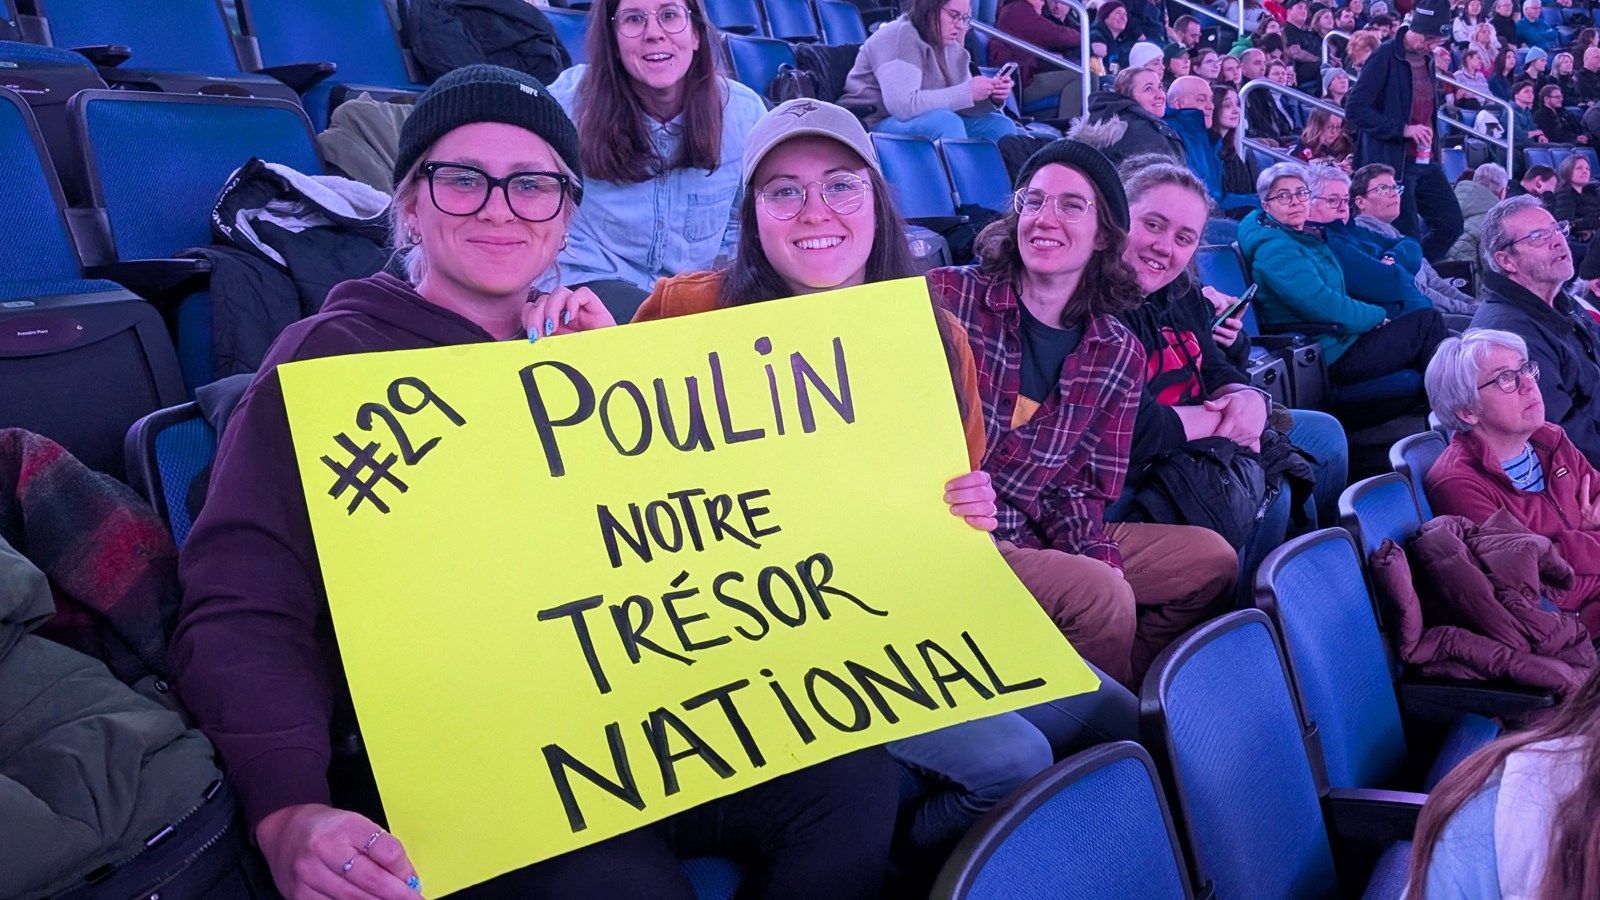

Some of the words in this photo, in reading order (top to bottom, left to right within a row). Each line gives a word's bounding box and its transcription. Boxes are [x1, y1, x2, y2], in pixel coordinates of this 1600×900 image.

[320, 376, 467, 516] #29
[596, 487, 783, 569] NOTRE
[536, 552, 889, 695] TRÉSOR
